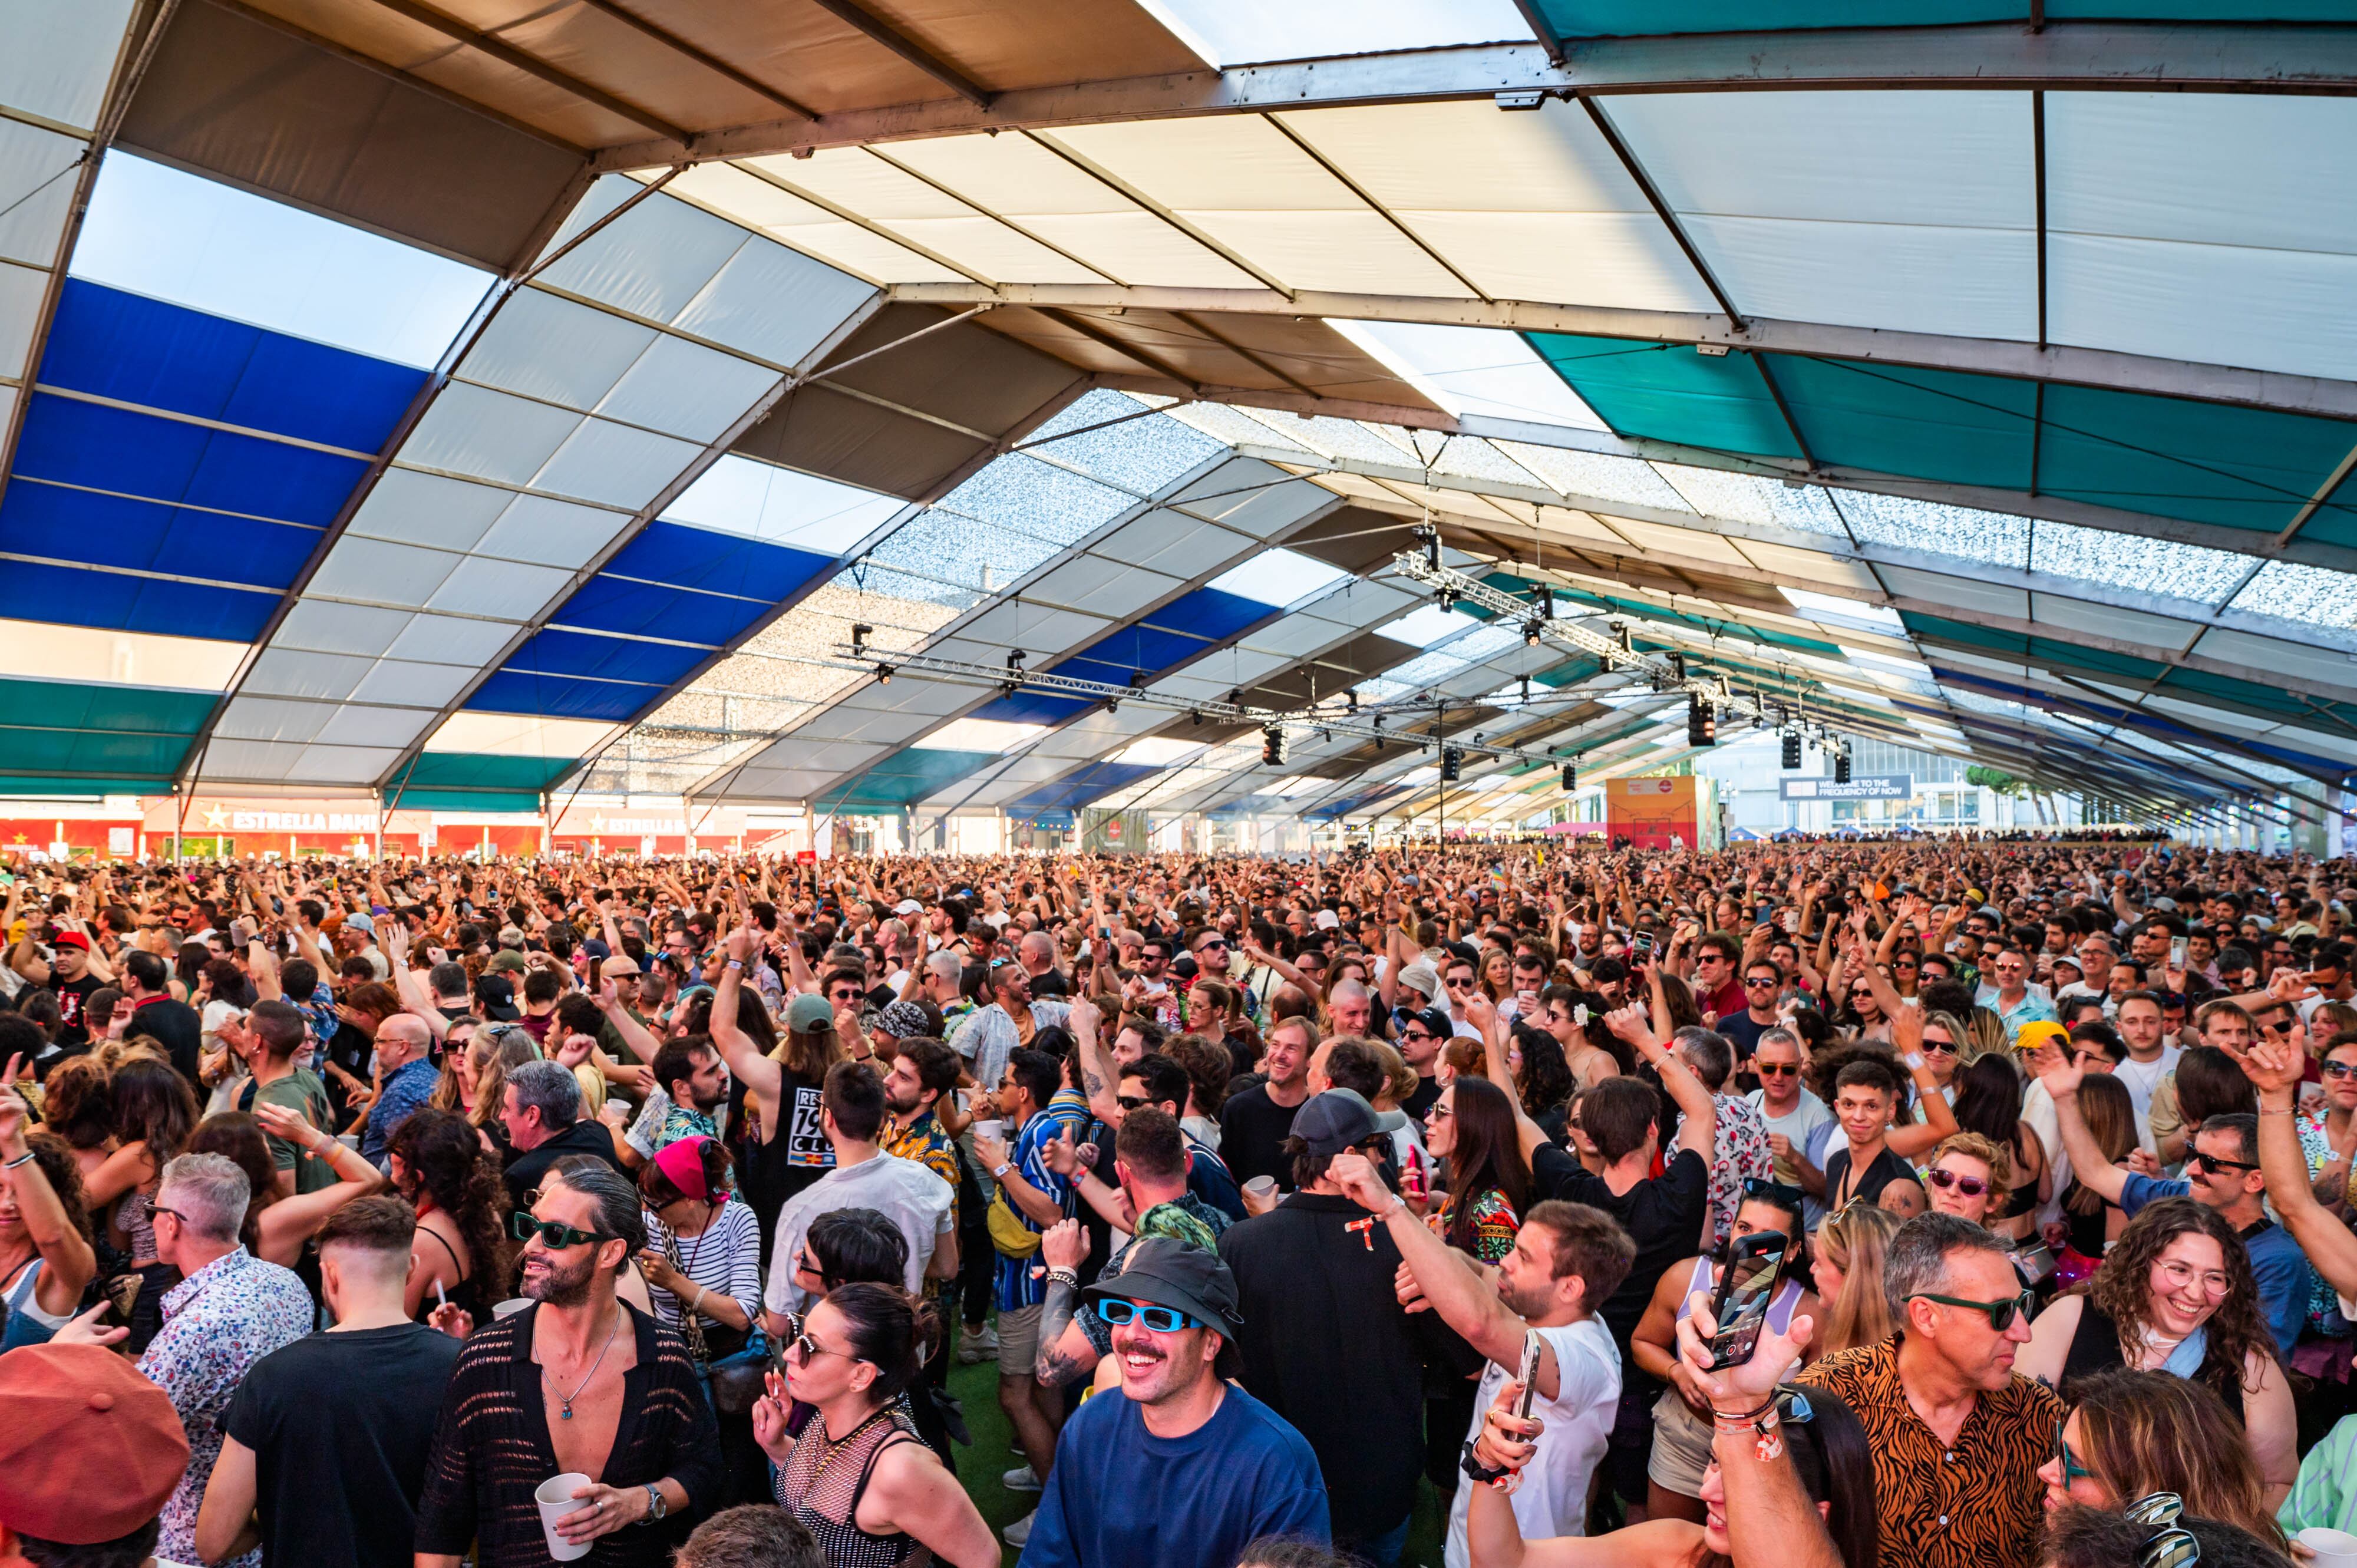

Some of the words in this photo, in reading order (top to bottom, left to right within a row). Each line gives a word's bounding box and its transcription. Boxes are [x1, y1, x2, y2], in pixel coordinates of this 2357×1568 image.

[1861, 779, 1873, 788] TO
[1873, 779, 1890, 787] THE
[1819, 787, 1867, 796] FREQUENCY
[1869, 787, 1880, 795] OF
[1881, 787, 1902, 795] NOW
[233, 812, 326, 830] ESTRELLA
[800, 1092, 816, 1105] RE
